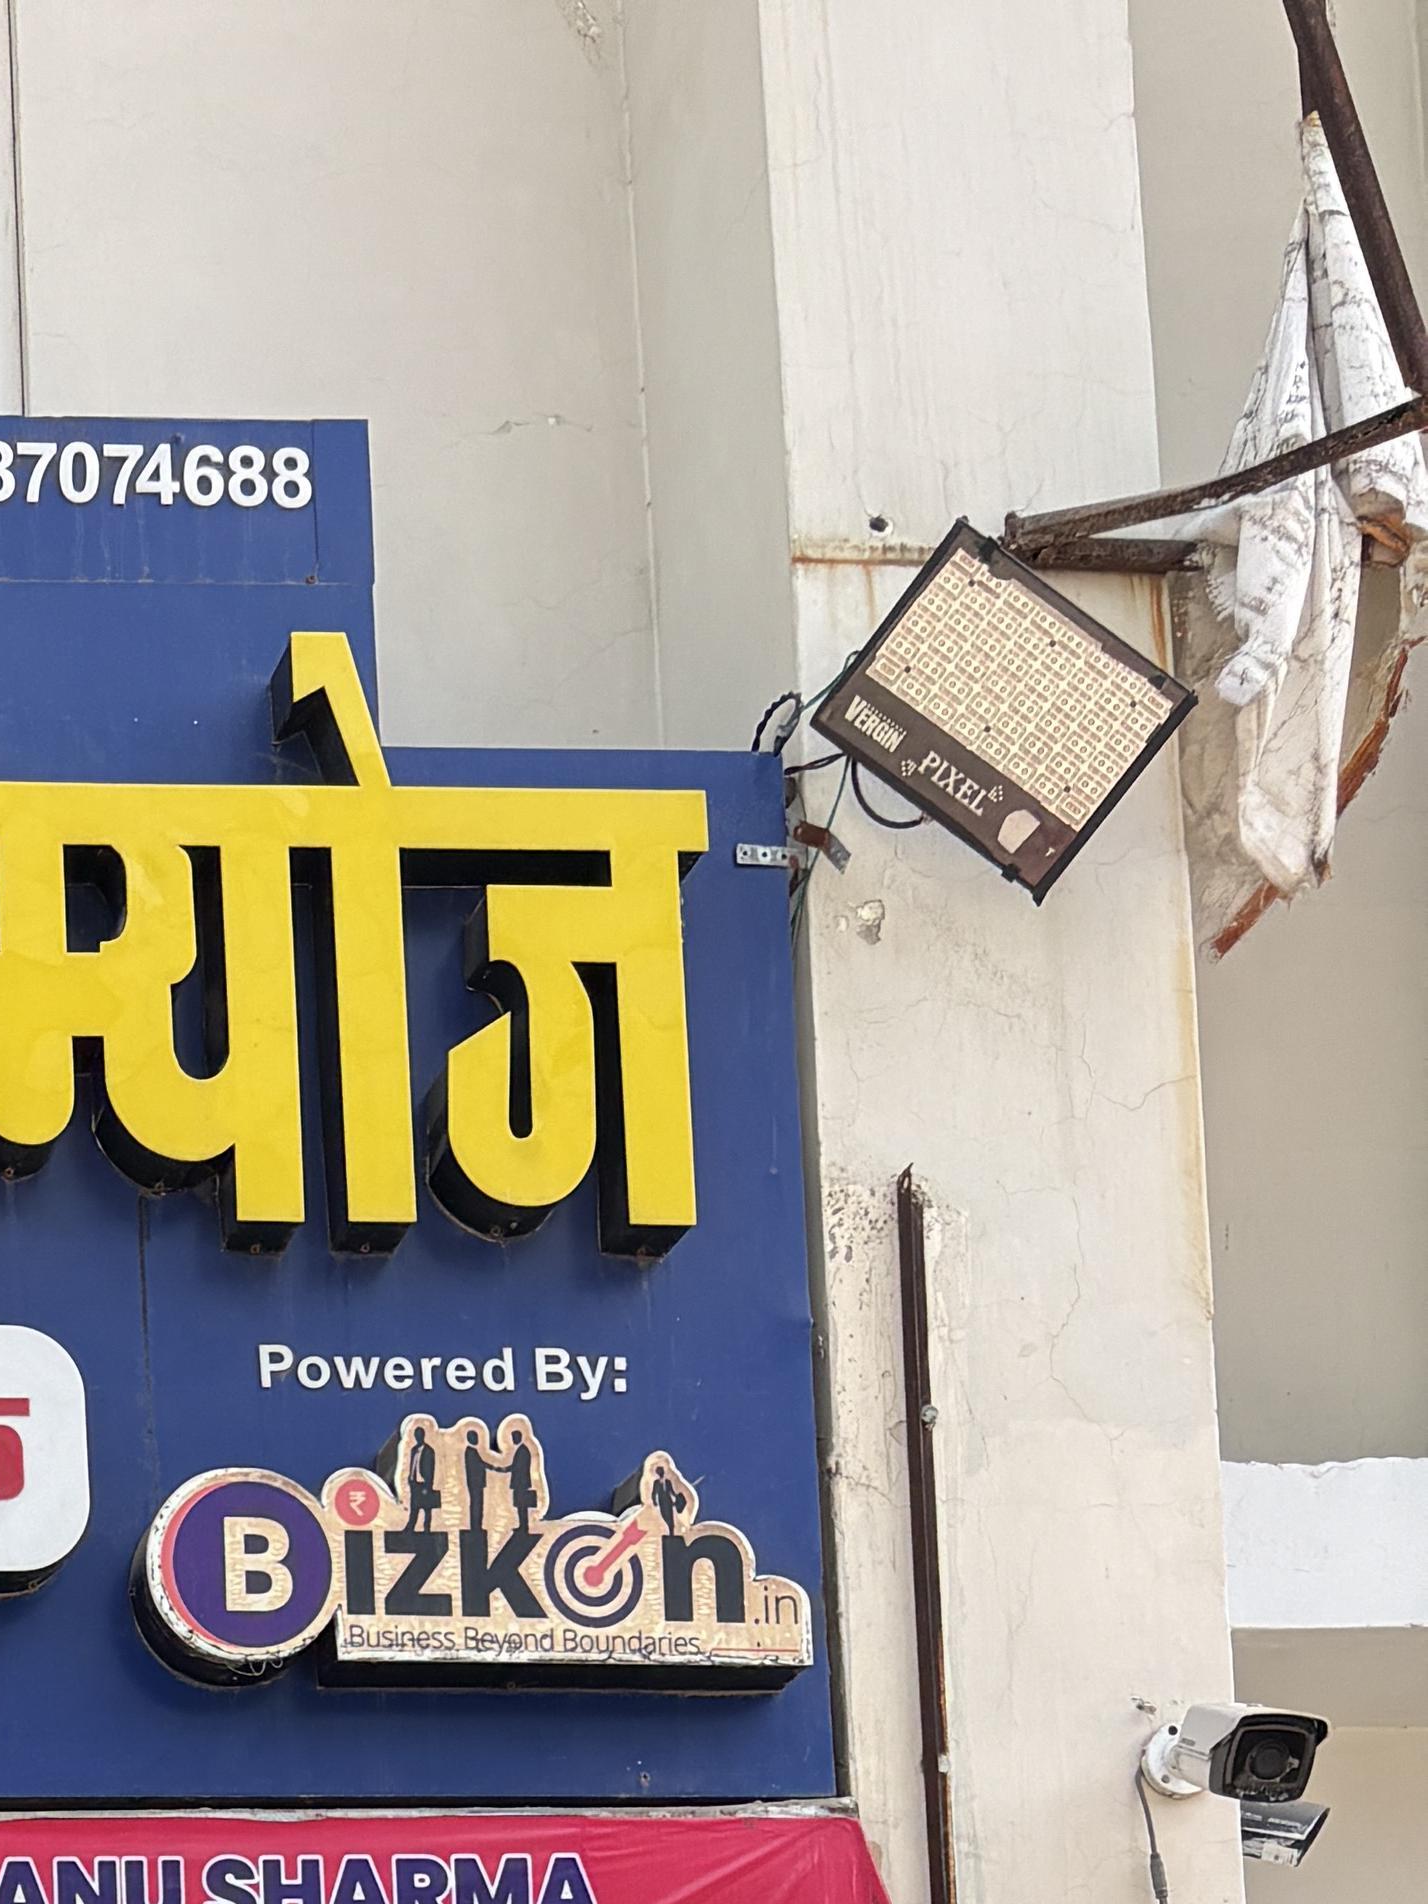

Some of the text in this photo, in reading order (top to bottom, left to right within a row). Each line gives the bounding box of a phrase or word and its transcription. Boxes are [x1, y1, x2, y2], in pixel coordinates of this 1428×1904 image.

[845, 695, 987, 816] VERGIN PIXEL
[258, 1344, 629, 1400] Powered By:
[349, 1624, 701, 1657] Business Beyond Boundaries
